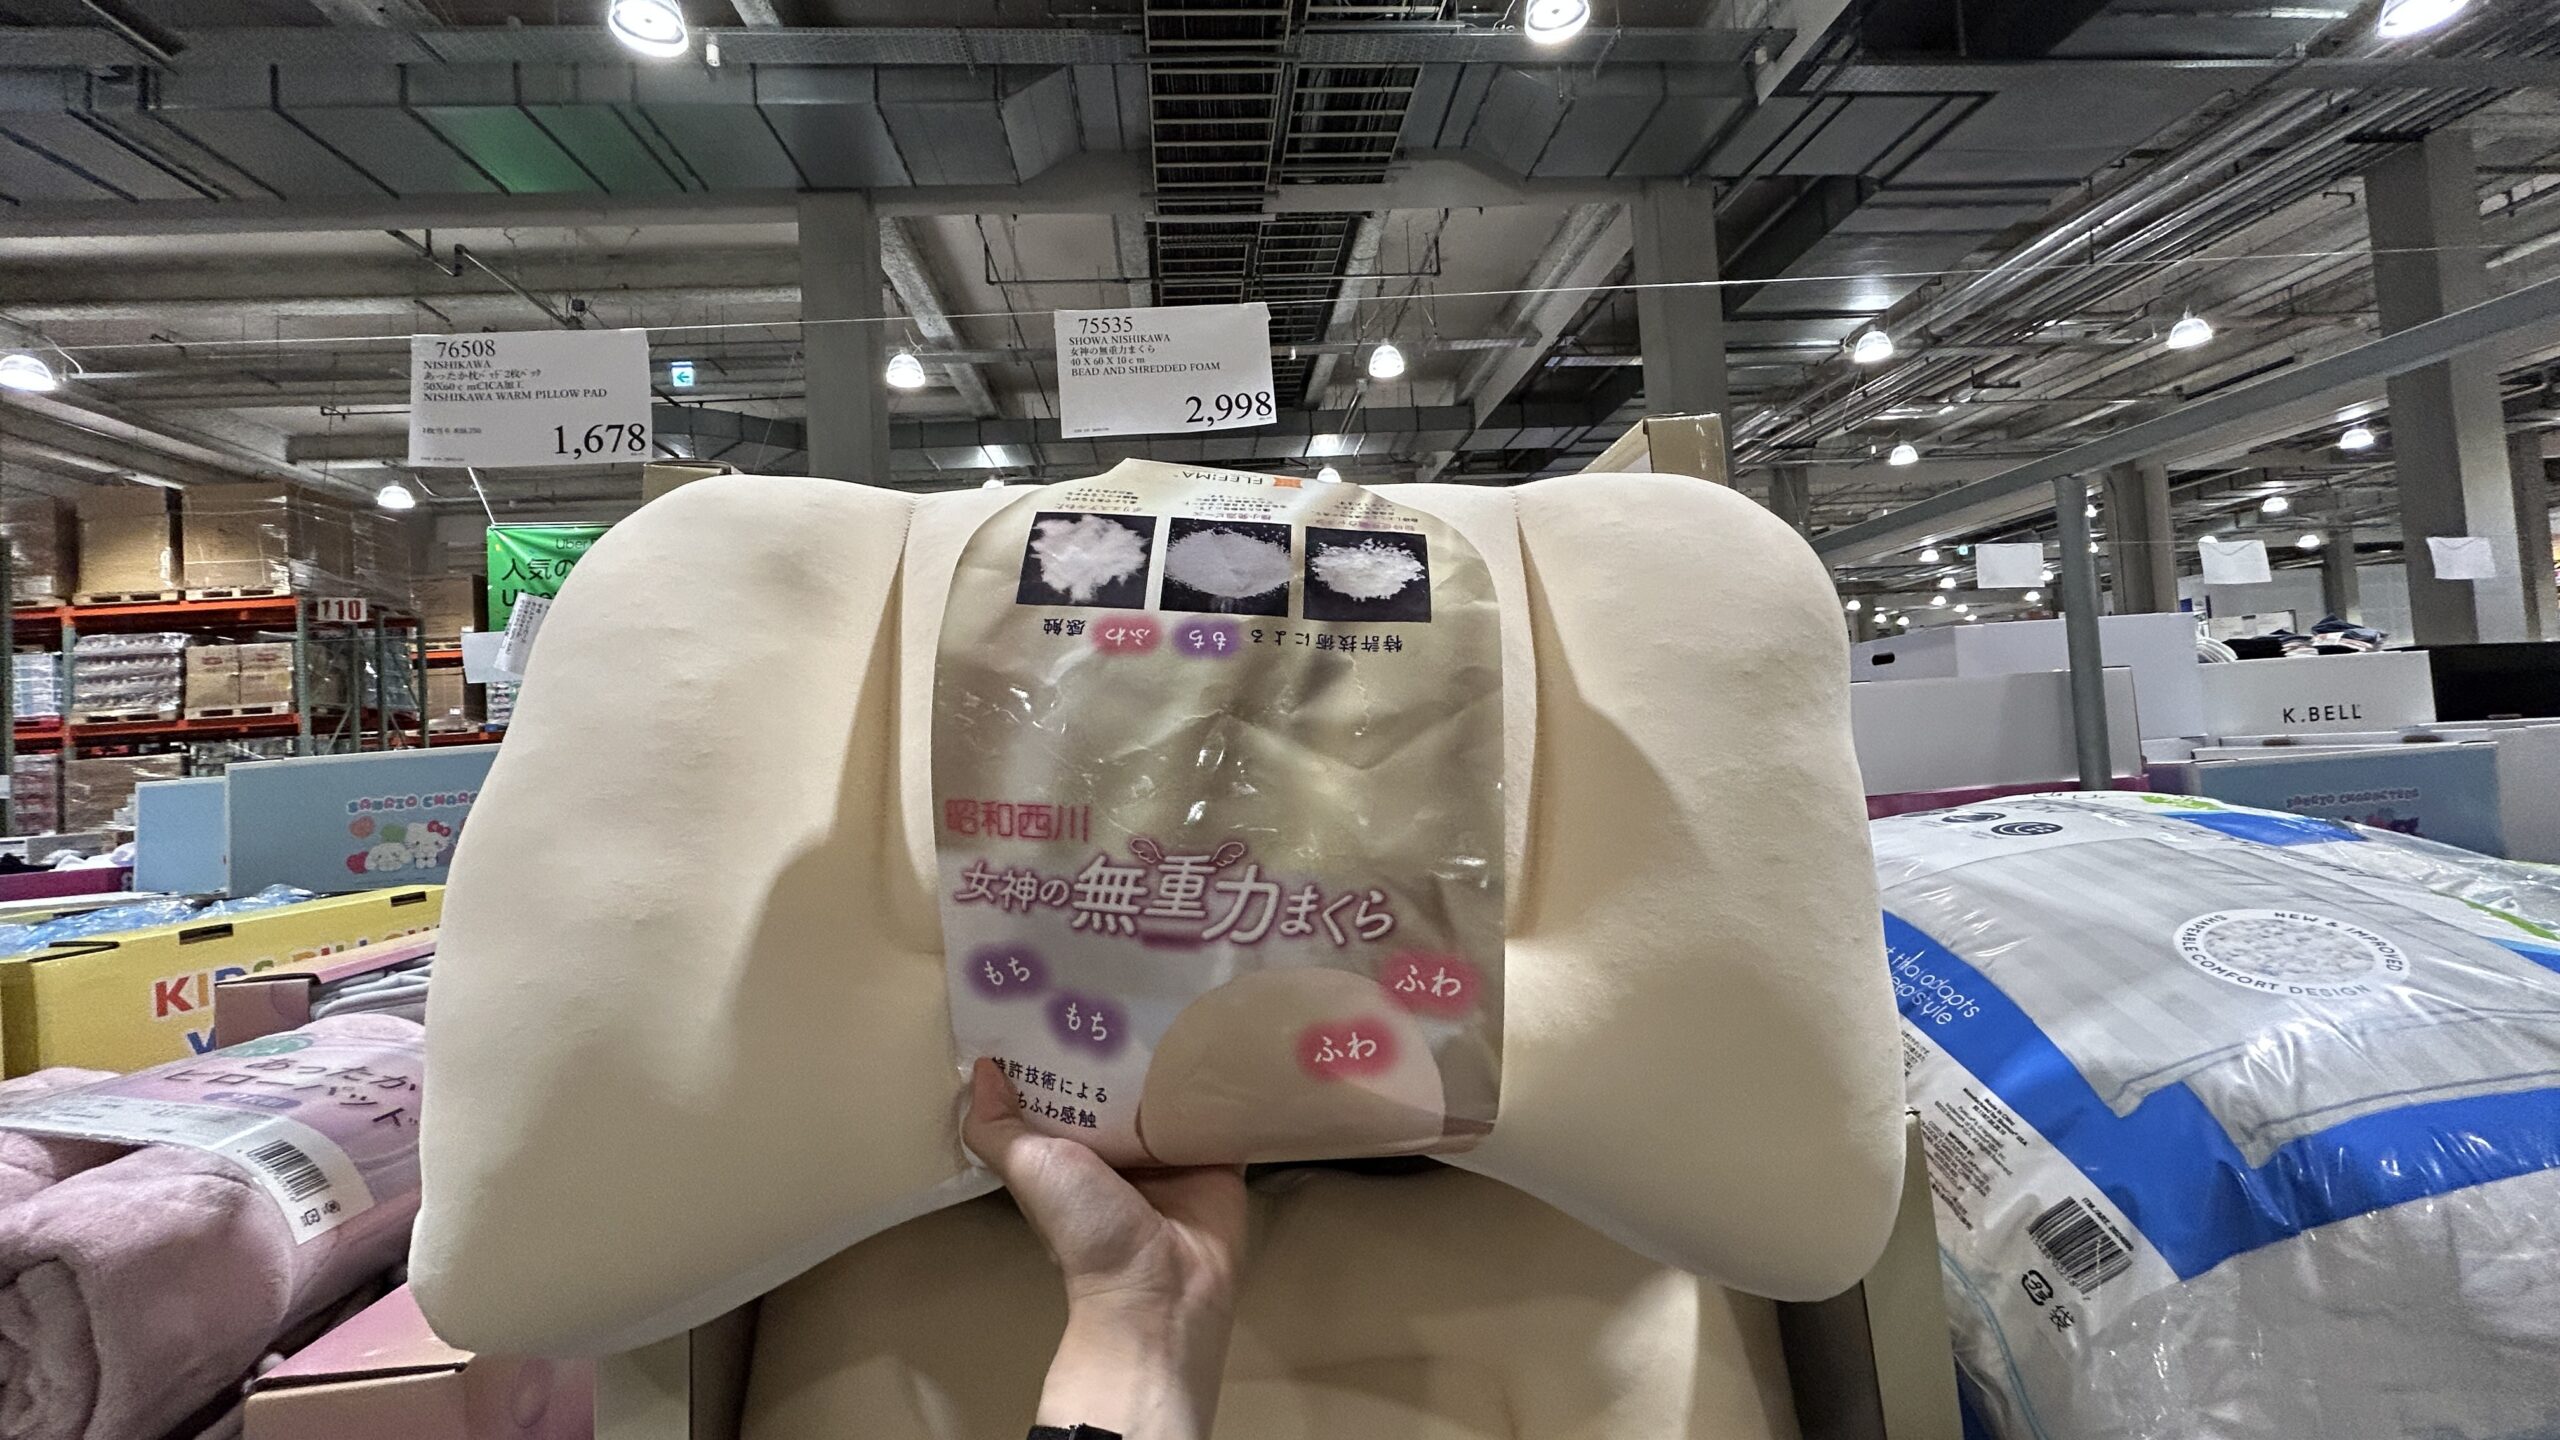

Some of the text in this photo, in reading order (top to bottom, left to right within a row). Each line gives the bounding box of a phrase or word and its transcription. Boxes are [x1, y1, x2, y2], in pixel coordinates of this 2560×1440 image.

[1069, 334, 1170, 345] SHOWA NISHIKAWA
[1078, 316, 1133, 334] 75535
[435, 339, 496, 358] 76508
[1071, 345, 1155, 356] 女神の無重力まくら
[423, 361, 491, 369] NISHIKAWA
[1072, 362, 1221, 376] BEAD AND SHREDDED FOAM
[423, 388, 607, 401] NISHIKAWA WARM PILLOW PAD
[1186, 391, 1272, 427] 2,998
[554, 423, 646, 459] 1,678
[556, 538, 588, 550] Uber
[1043, 618, 1402, 653] 特許技術による もち ふわ 感触
[2283, 704, 2362, 723] K.BELL
[946, 799, 1090, 843] 昭和西川
[956, 852, 1394, 946] 女神の無重力まくら
[2182, 914, 2371, 998] SHAPEABLE COMFORT DESIGN
[2274, 912, 2318, 923] NEW
[2346, 927, 2403, 972] IMPROVED
[982, 955, 1032, 987] もち
[1394, 964, 1463, 997] ふわ
[1065, 1002, 1109, 1043] もち
[1313, 1031, 1378, 1063] ふわ
[245, 1058, 417, 1092] あったか
